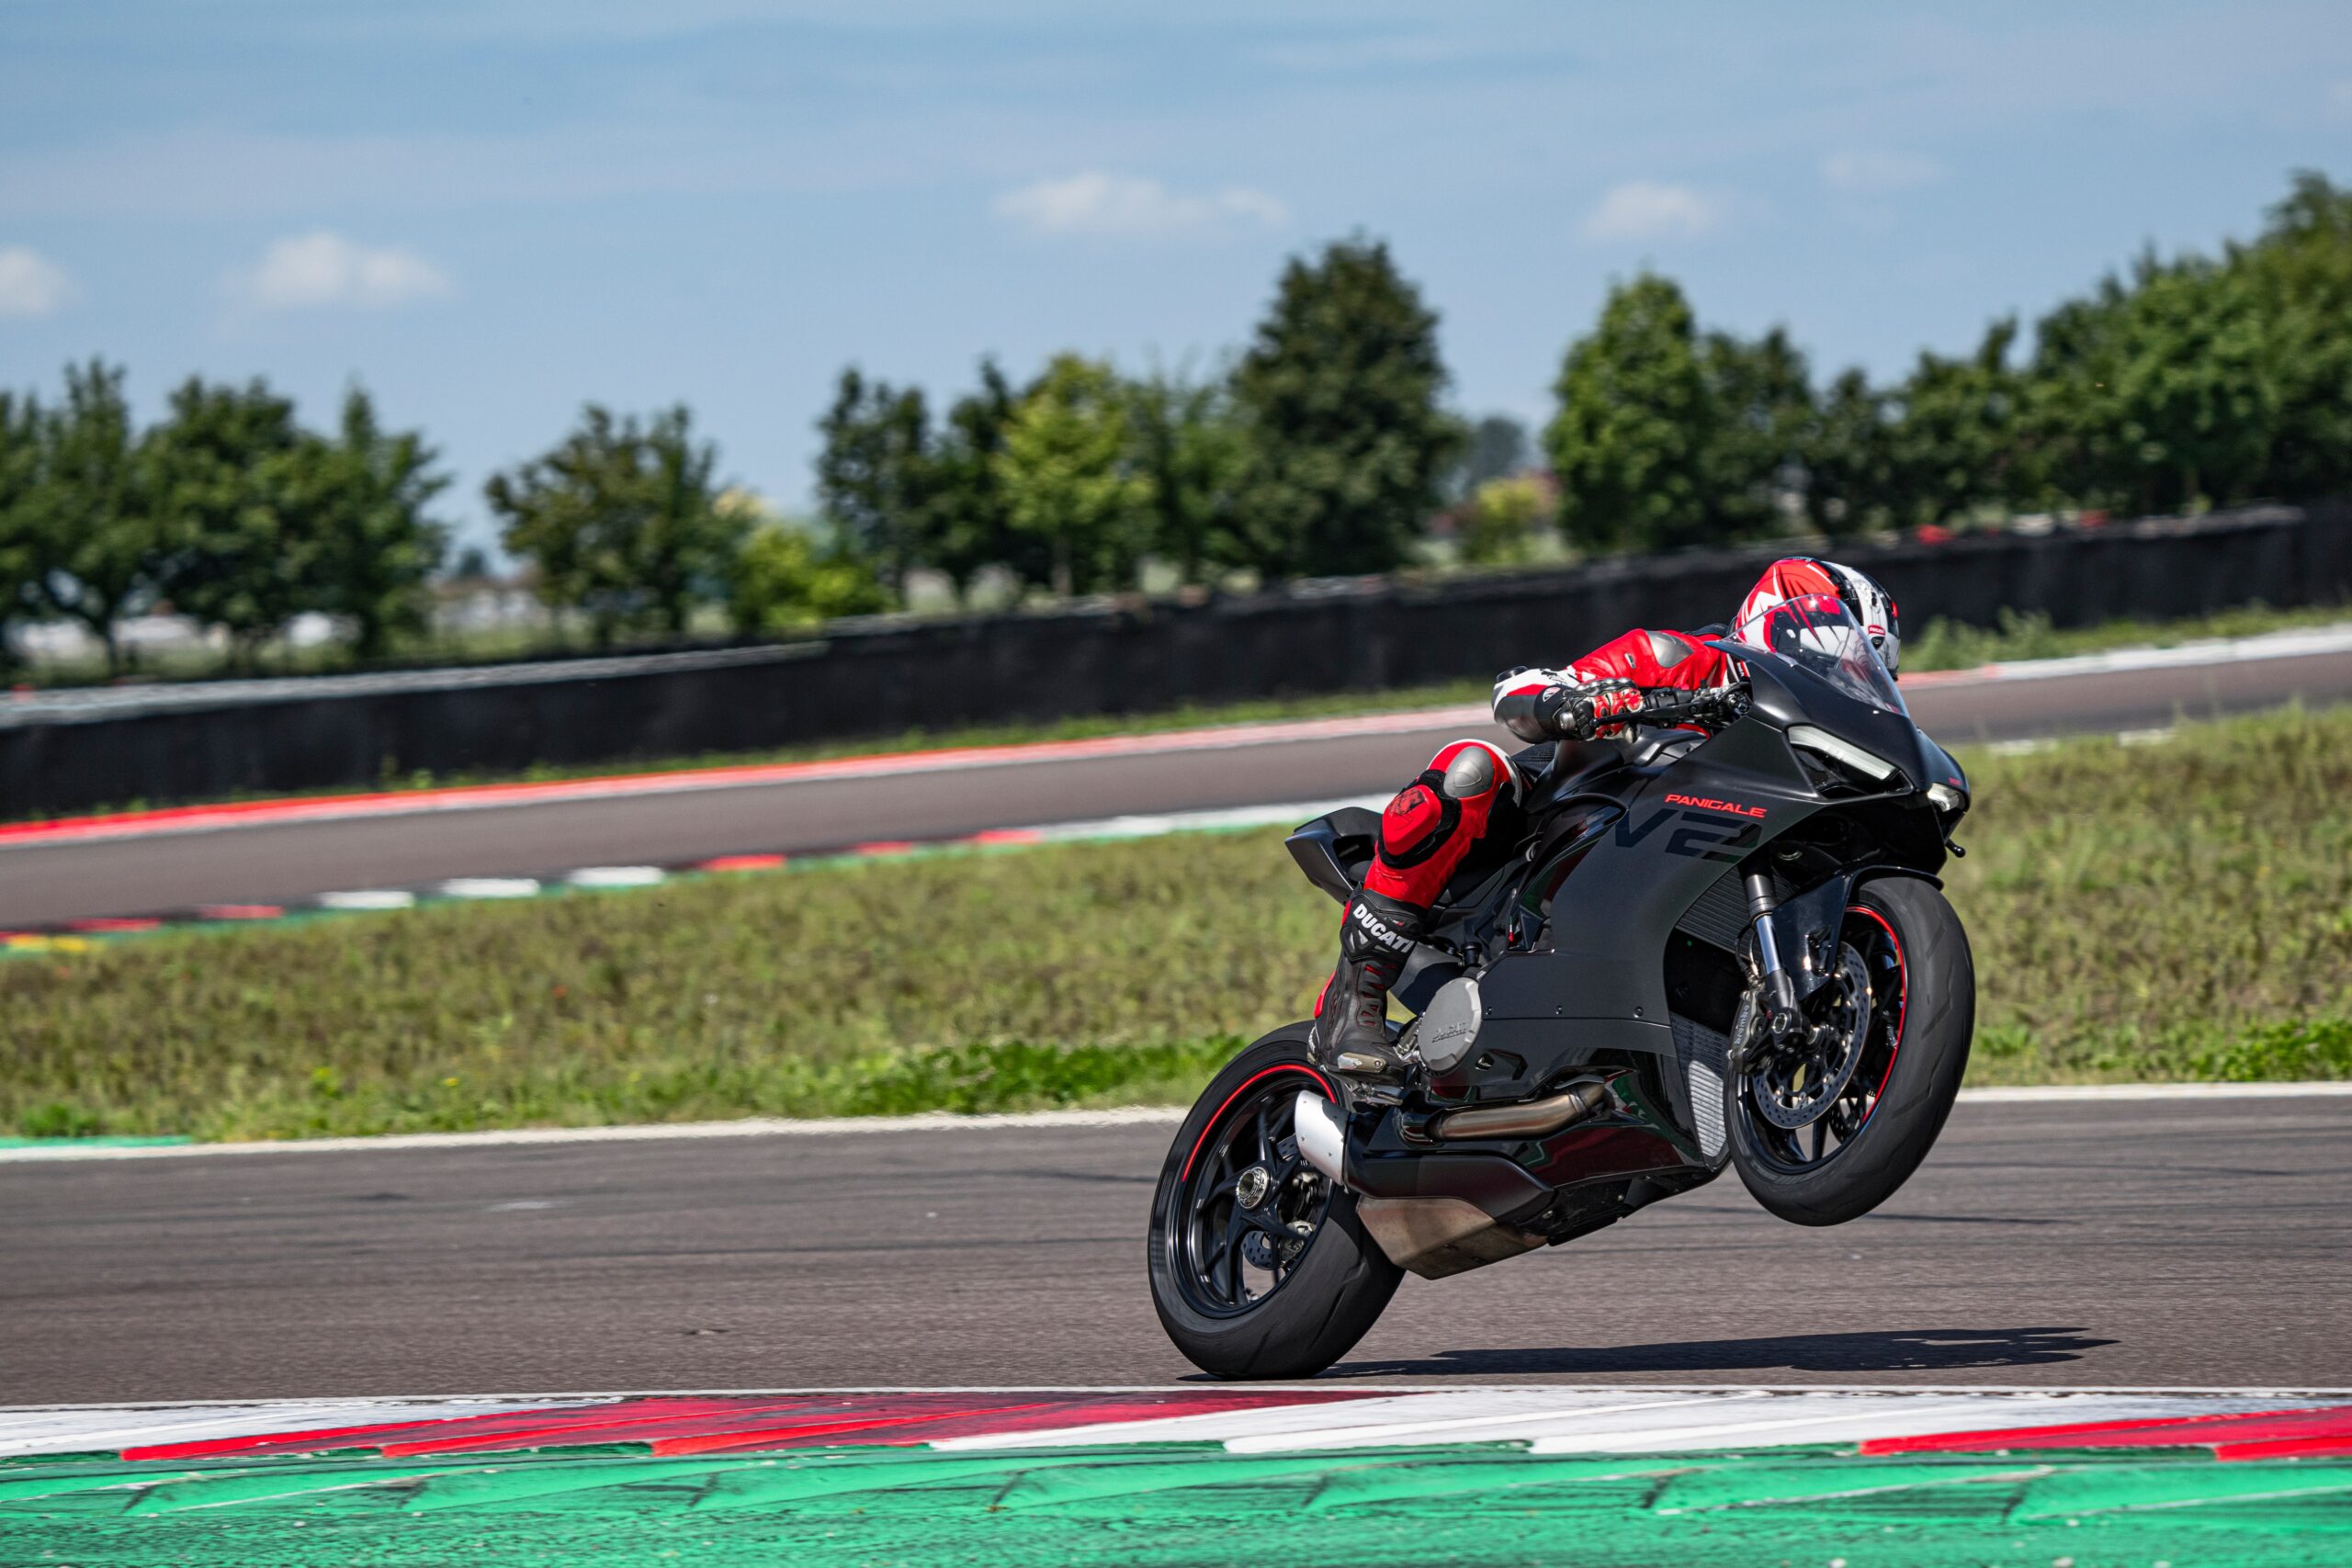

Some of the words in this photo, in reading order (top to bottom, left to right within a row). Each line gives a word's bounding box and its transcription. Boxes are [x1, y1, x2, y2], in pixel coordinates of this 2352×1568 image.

[1665, 794, 1768, 818] PANIGALE
[1615, 808, 1762, 863] V2
[1353, 903, 1415, 953] DUCATI
[1735, 1005, 1749, 1044] brembo
